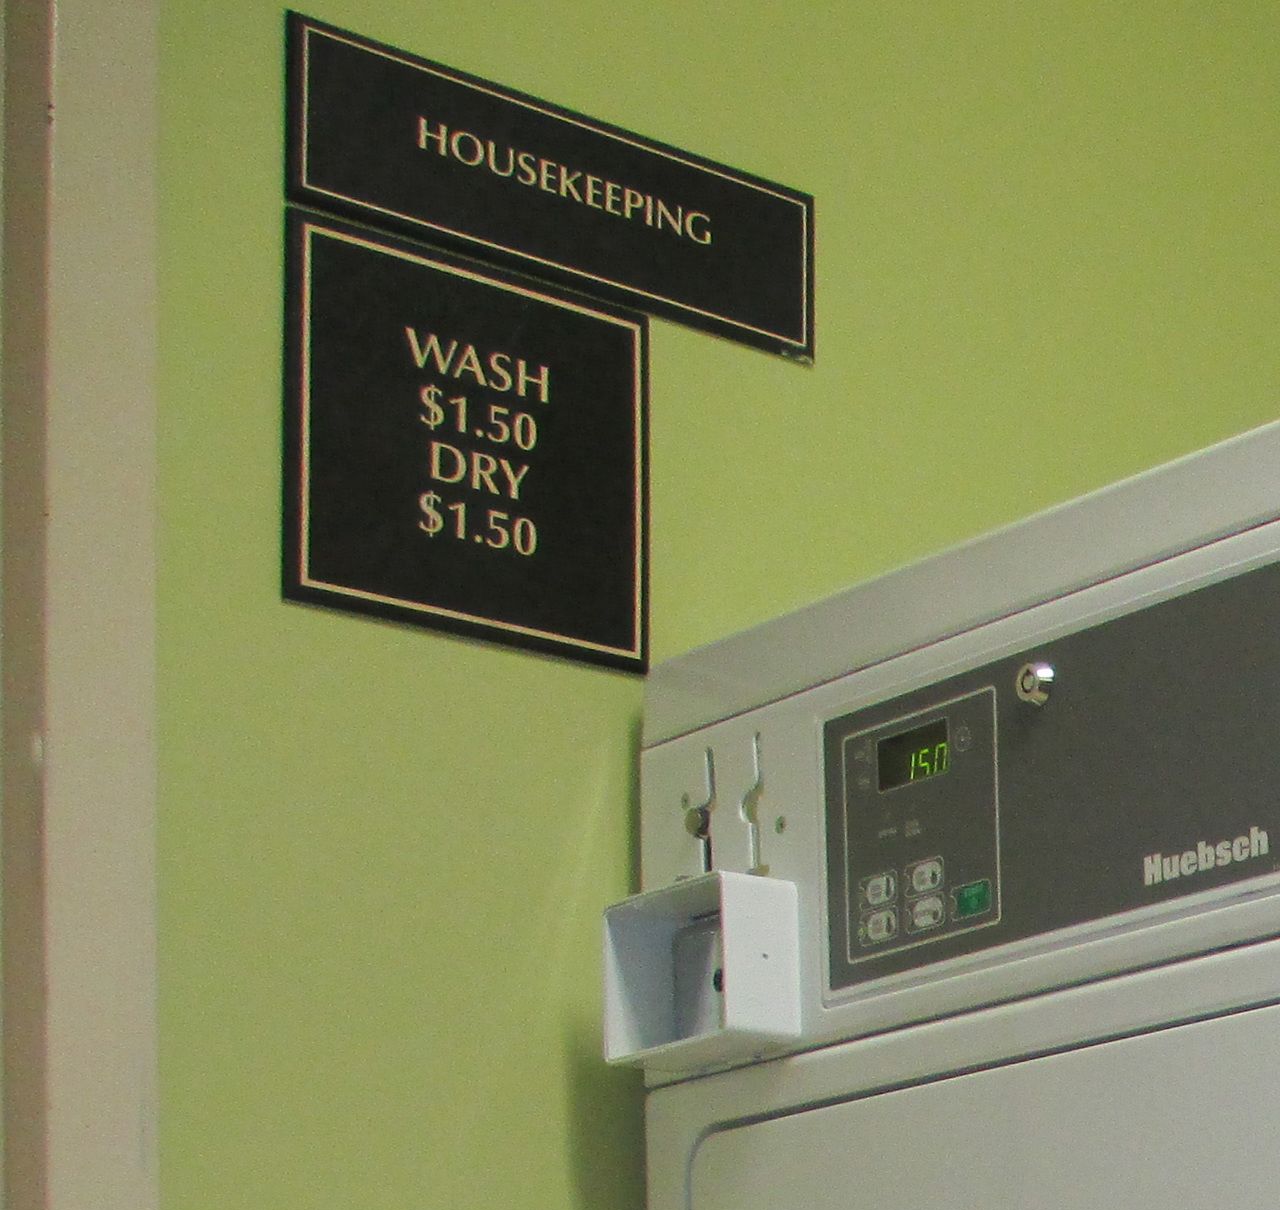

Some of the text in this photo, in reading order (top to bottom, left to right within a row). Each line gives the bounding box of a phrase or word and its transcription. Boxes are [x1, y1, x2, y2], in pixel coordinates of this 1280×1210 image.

[417, 116, 713, 245] HOUSEKEEPING
[405, 326, 550, 402] WASH
[420, 384, 538, 451] $1.50
[429, 441, 530, 501] DRY
[418, 491, 538, 556] $1.50
[1144, 826, 1269, 886] Huebsch
